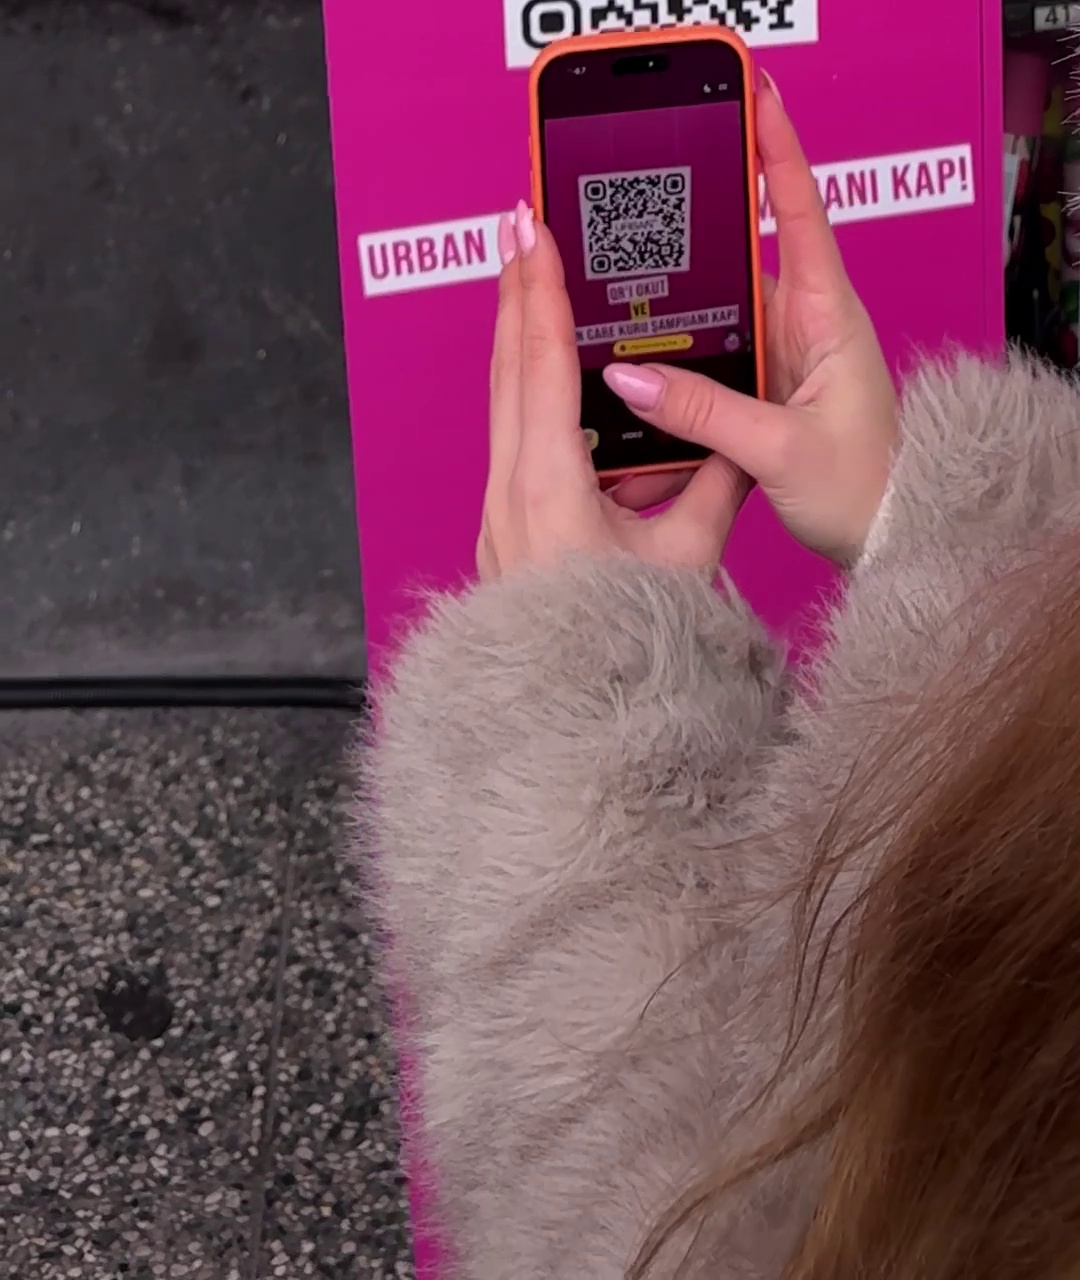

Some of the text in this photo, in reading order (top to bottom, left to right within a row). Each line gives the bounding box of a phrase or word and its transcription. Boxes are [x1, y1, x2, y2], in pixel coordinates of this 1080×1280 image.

[1045, 5, 1070, 25] 41
[367, 227, 487, 281] URBAN
[891, 155, 967, 202] KAP!
[636, 279, 666, 297] OKUT
[632, 301, 648, 317] VE
[586, 325, 615, 341] CARE
[618, 320, 648, 336] KURU
[712, 307, 738, 322] KAP!
